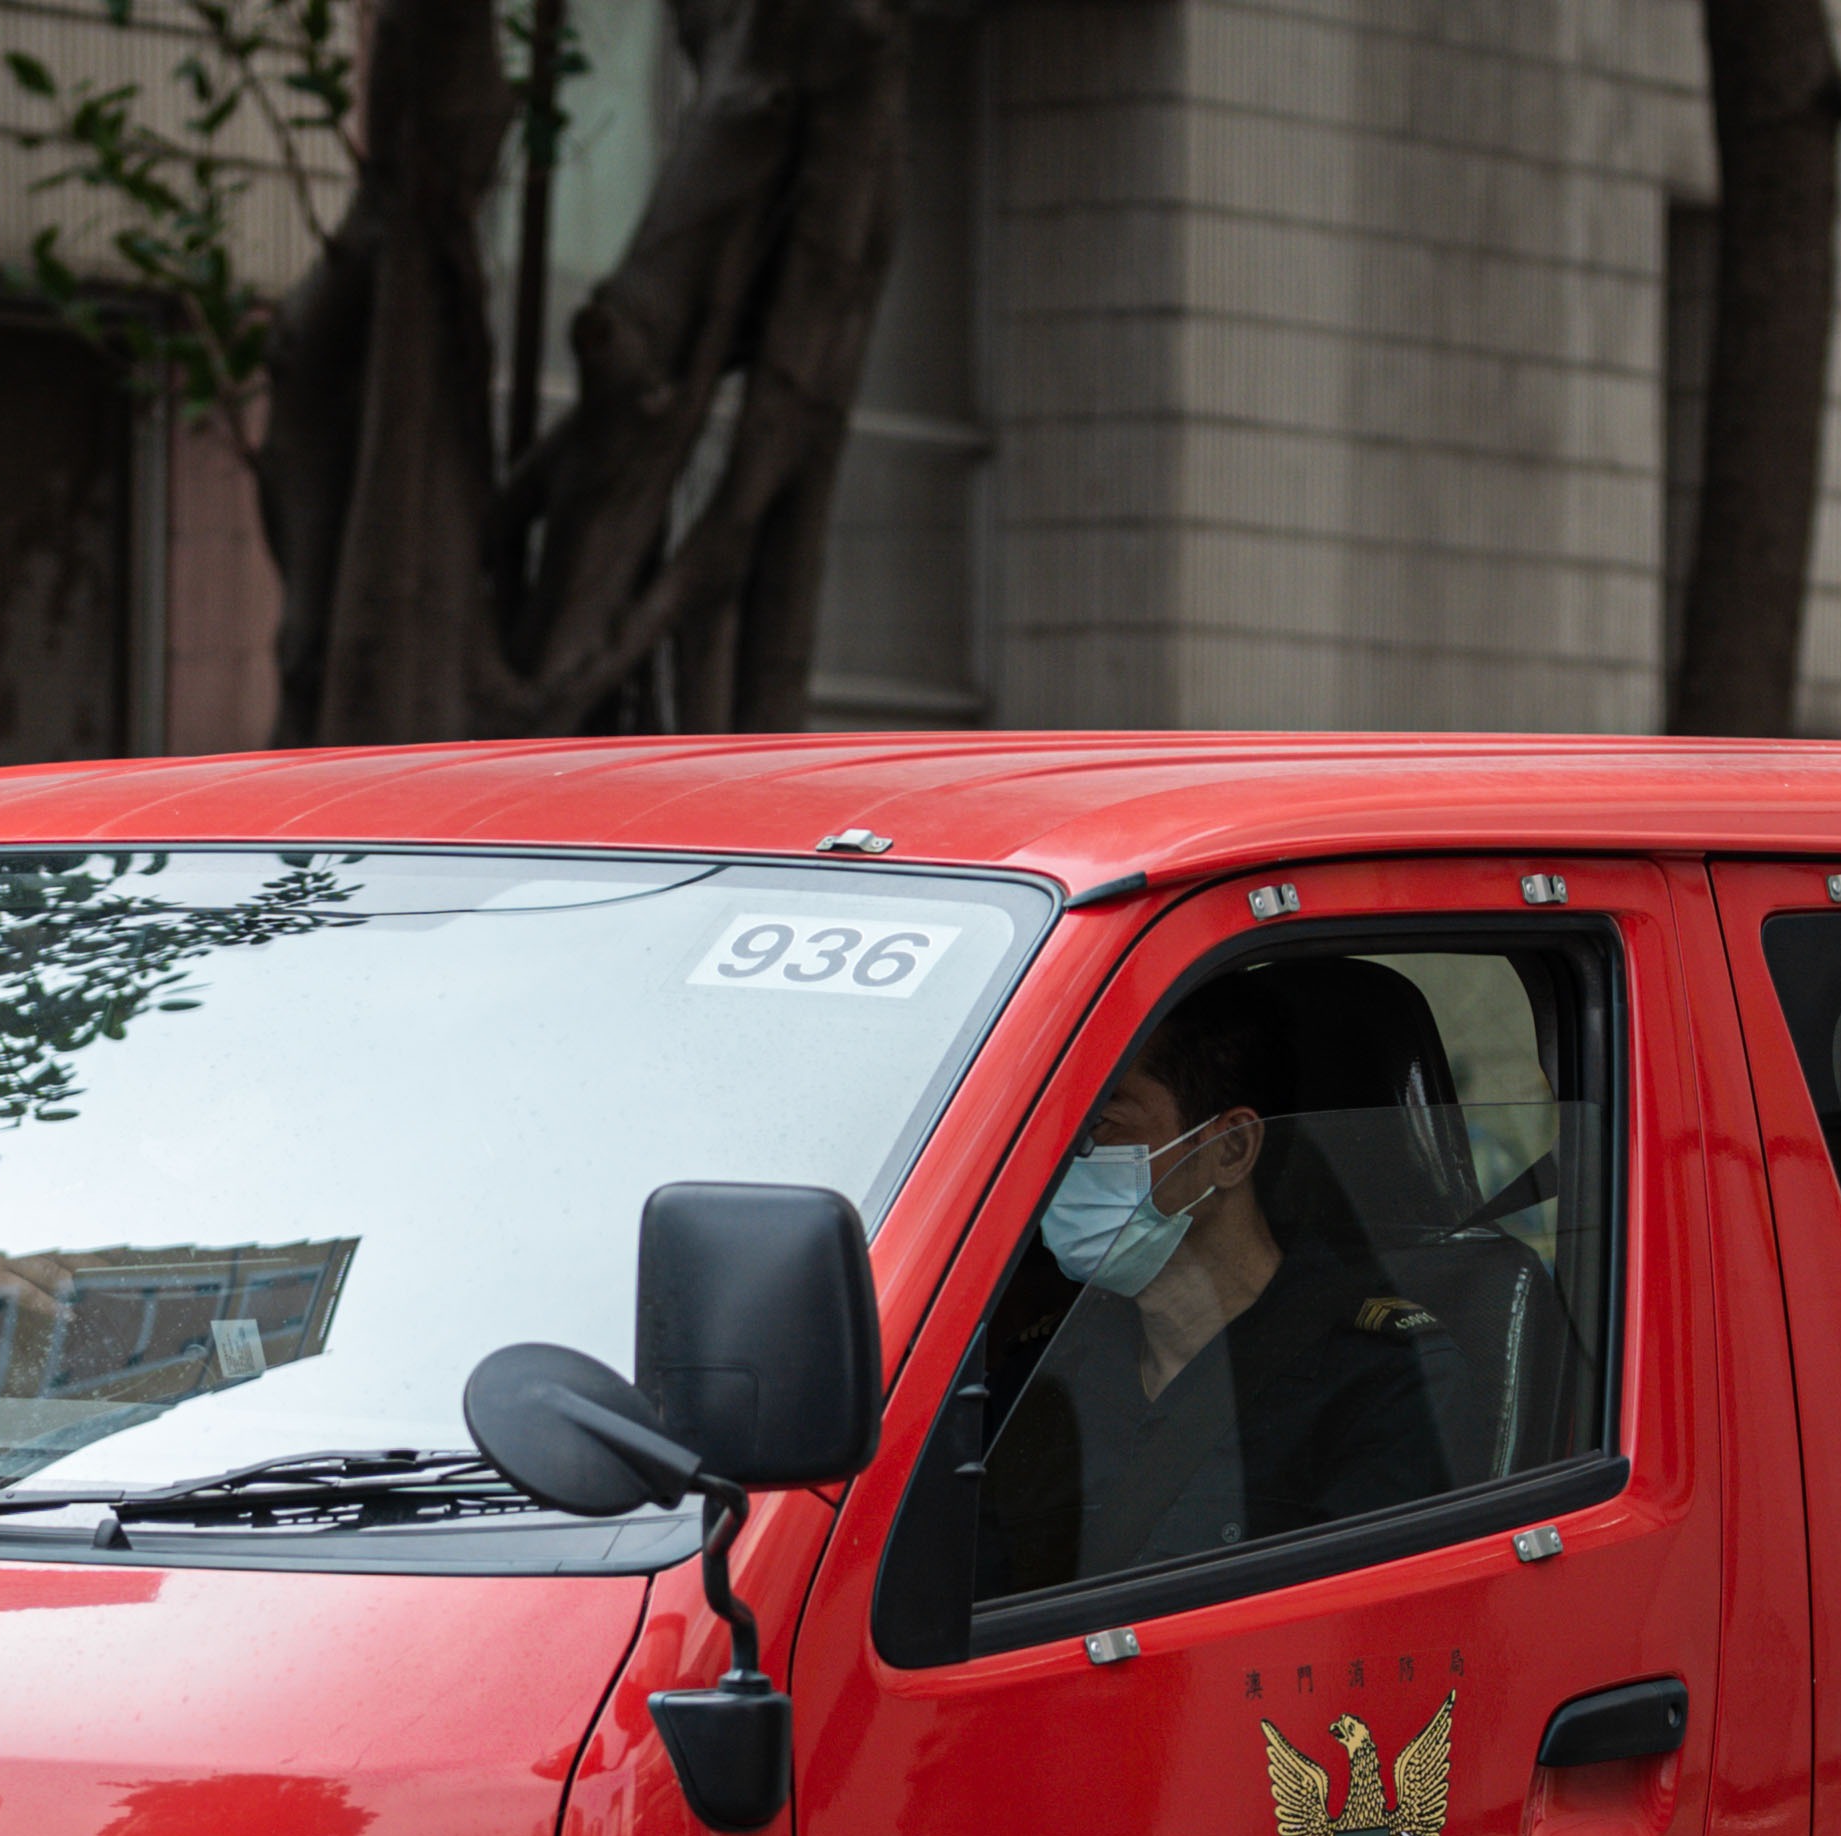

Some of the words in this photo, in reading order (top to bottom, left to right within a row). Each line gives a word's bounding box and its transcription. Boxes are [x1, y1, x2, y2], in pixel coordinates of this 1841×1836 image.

[718, 924, 930, 987] 936
[1244, 1648, 1465, 1700] 澳門消防局
